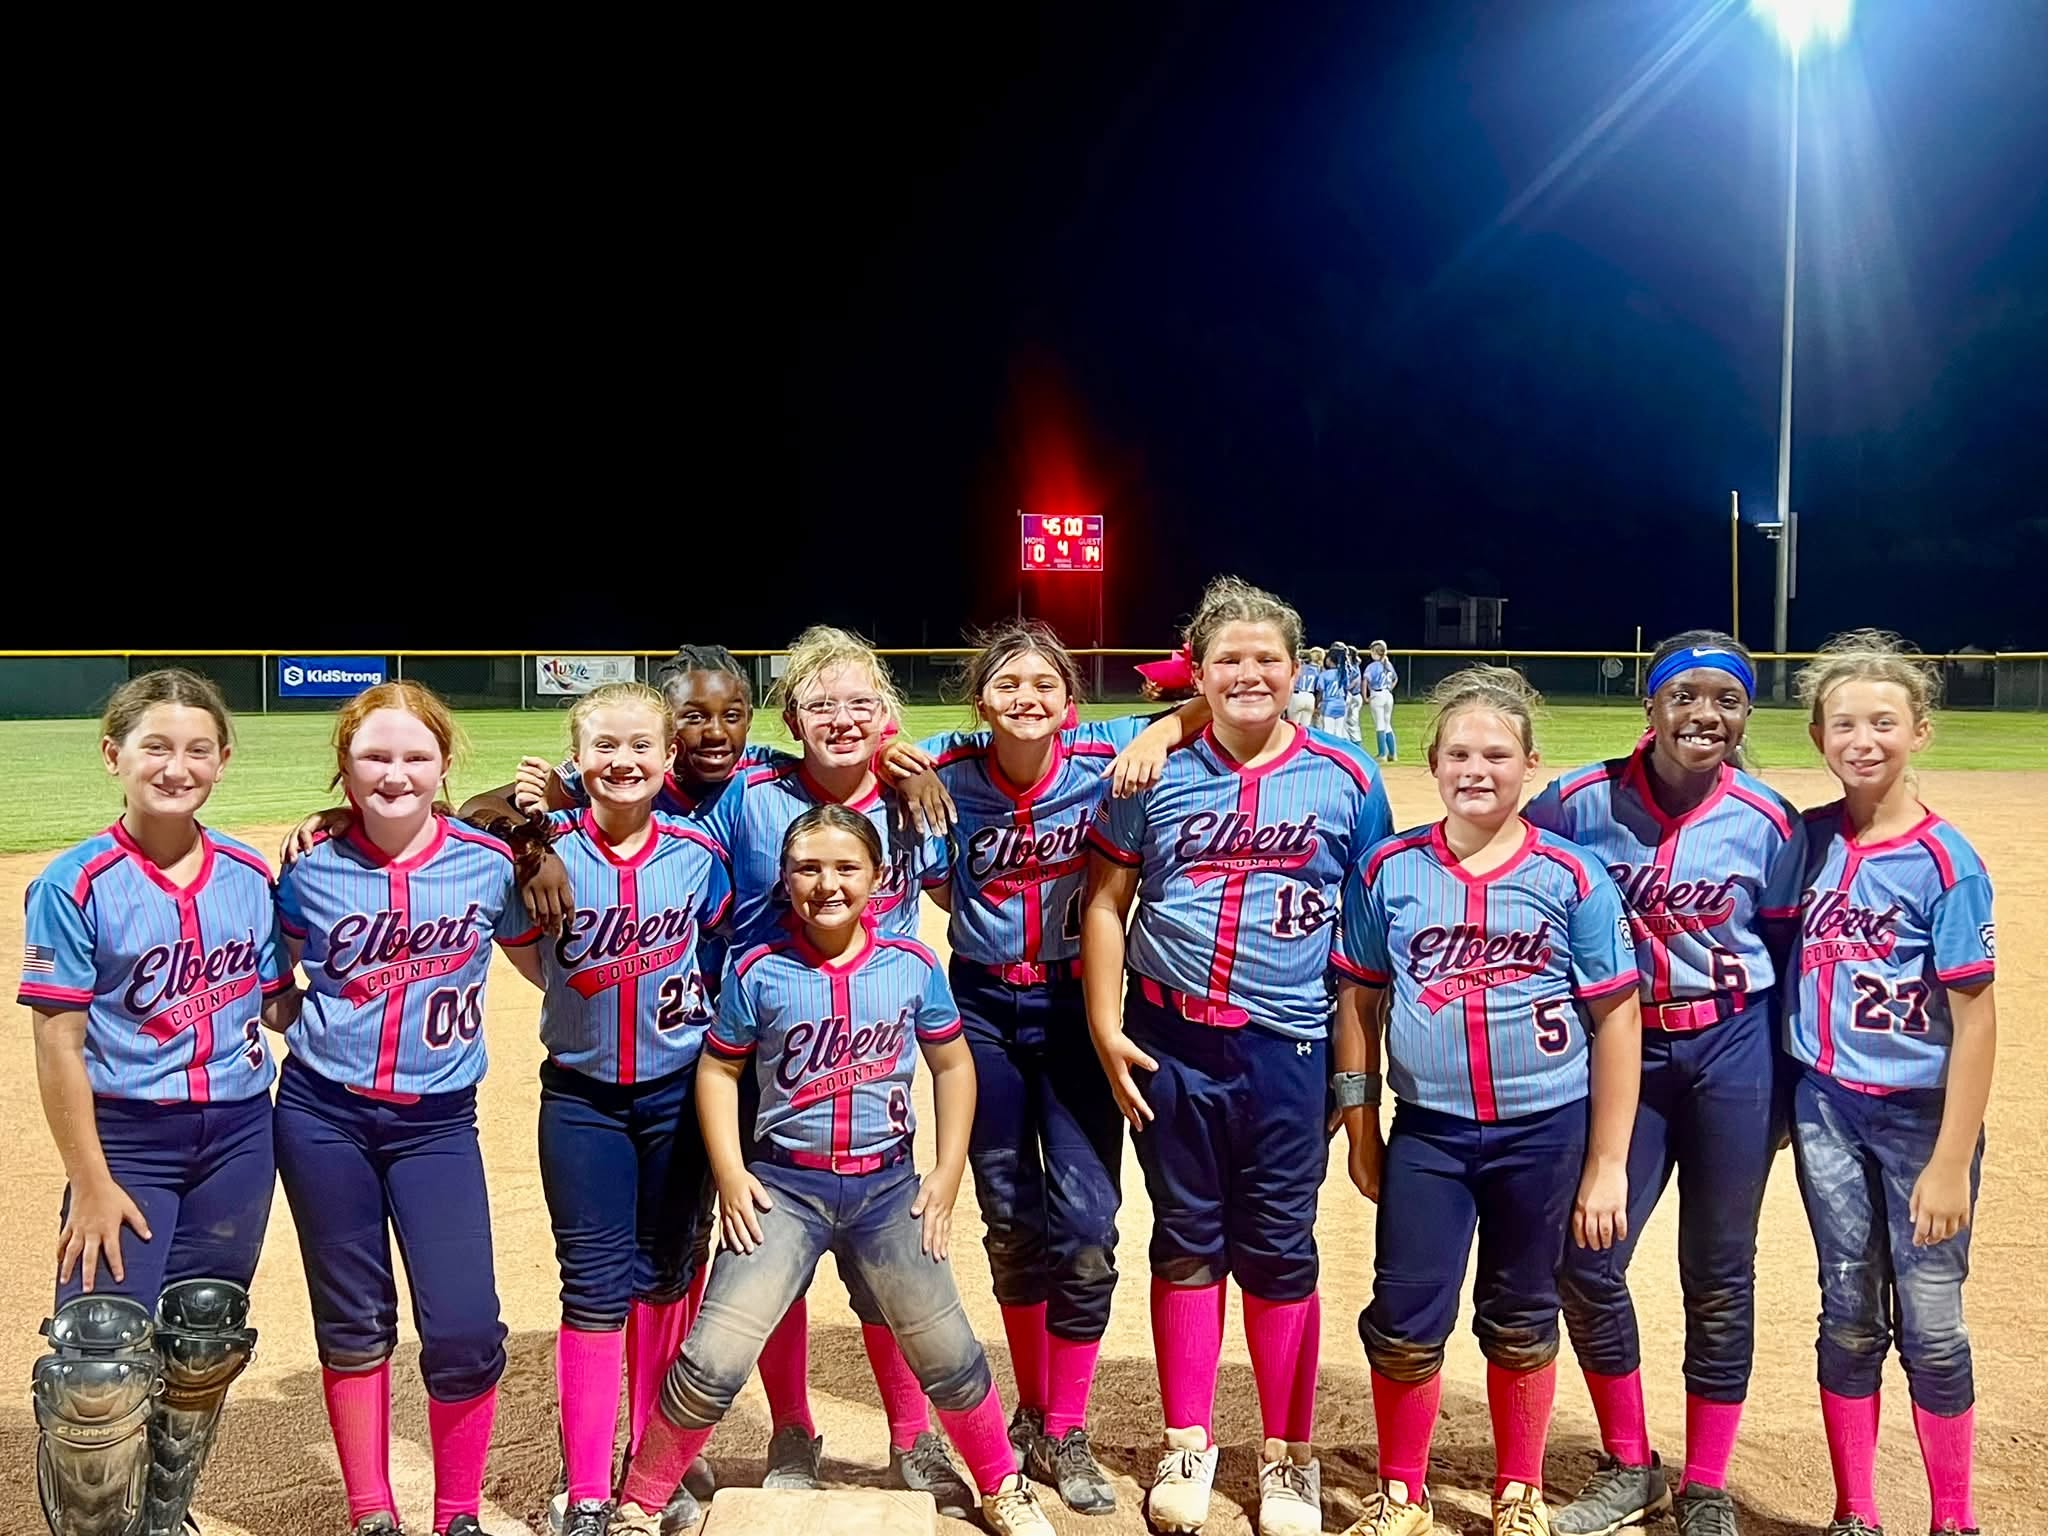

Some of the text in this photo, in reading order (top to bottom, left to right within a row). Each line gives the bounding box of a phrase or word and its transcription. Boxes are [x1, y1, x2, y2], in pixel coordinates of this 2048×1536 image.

[1025, 537, 1045, 545] HOME
[1033, 544, 1045, 563] 0
[1057, 540, 1069, 556] 4
[306, 669, 382, 685] KidStrong
[967, 808, 1093, 881] Elbert
[1175, 810, 1317, 863] Elbert
[555, 891, 695, 970] Elbert
[1271, 882, 1328, 938] 18
[323, 901, 480, 981] Elbert
[595, 947, 675, 985] COUNTY
[1407, 919, 1552, 984] Elbert
[124, 927, 258, 1016] Elbert
[366, 957, 451, 992] COUNTY
[1708, 947, 1751, 993] 6
[171, 982, 239, 1027] COUNTY
[422, 982, 486, 1051] 00
[1531, 997, 1571, 1057] 5
[1850, 972, 1931, 1035] 27
[775, 1008, 908, 1091] Elbert
